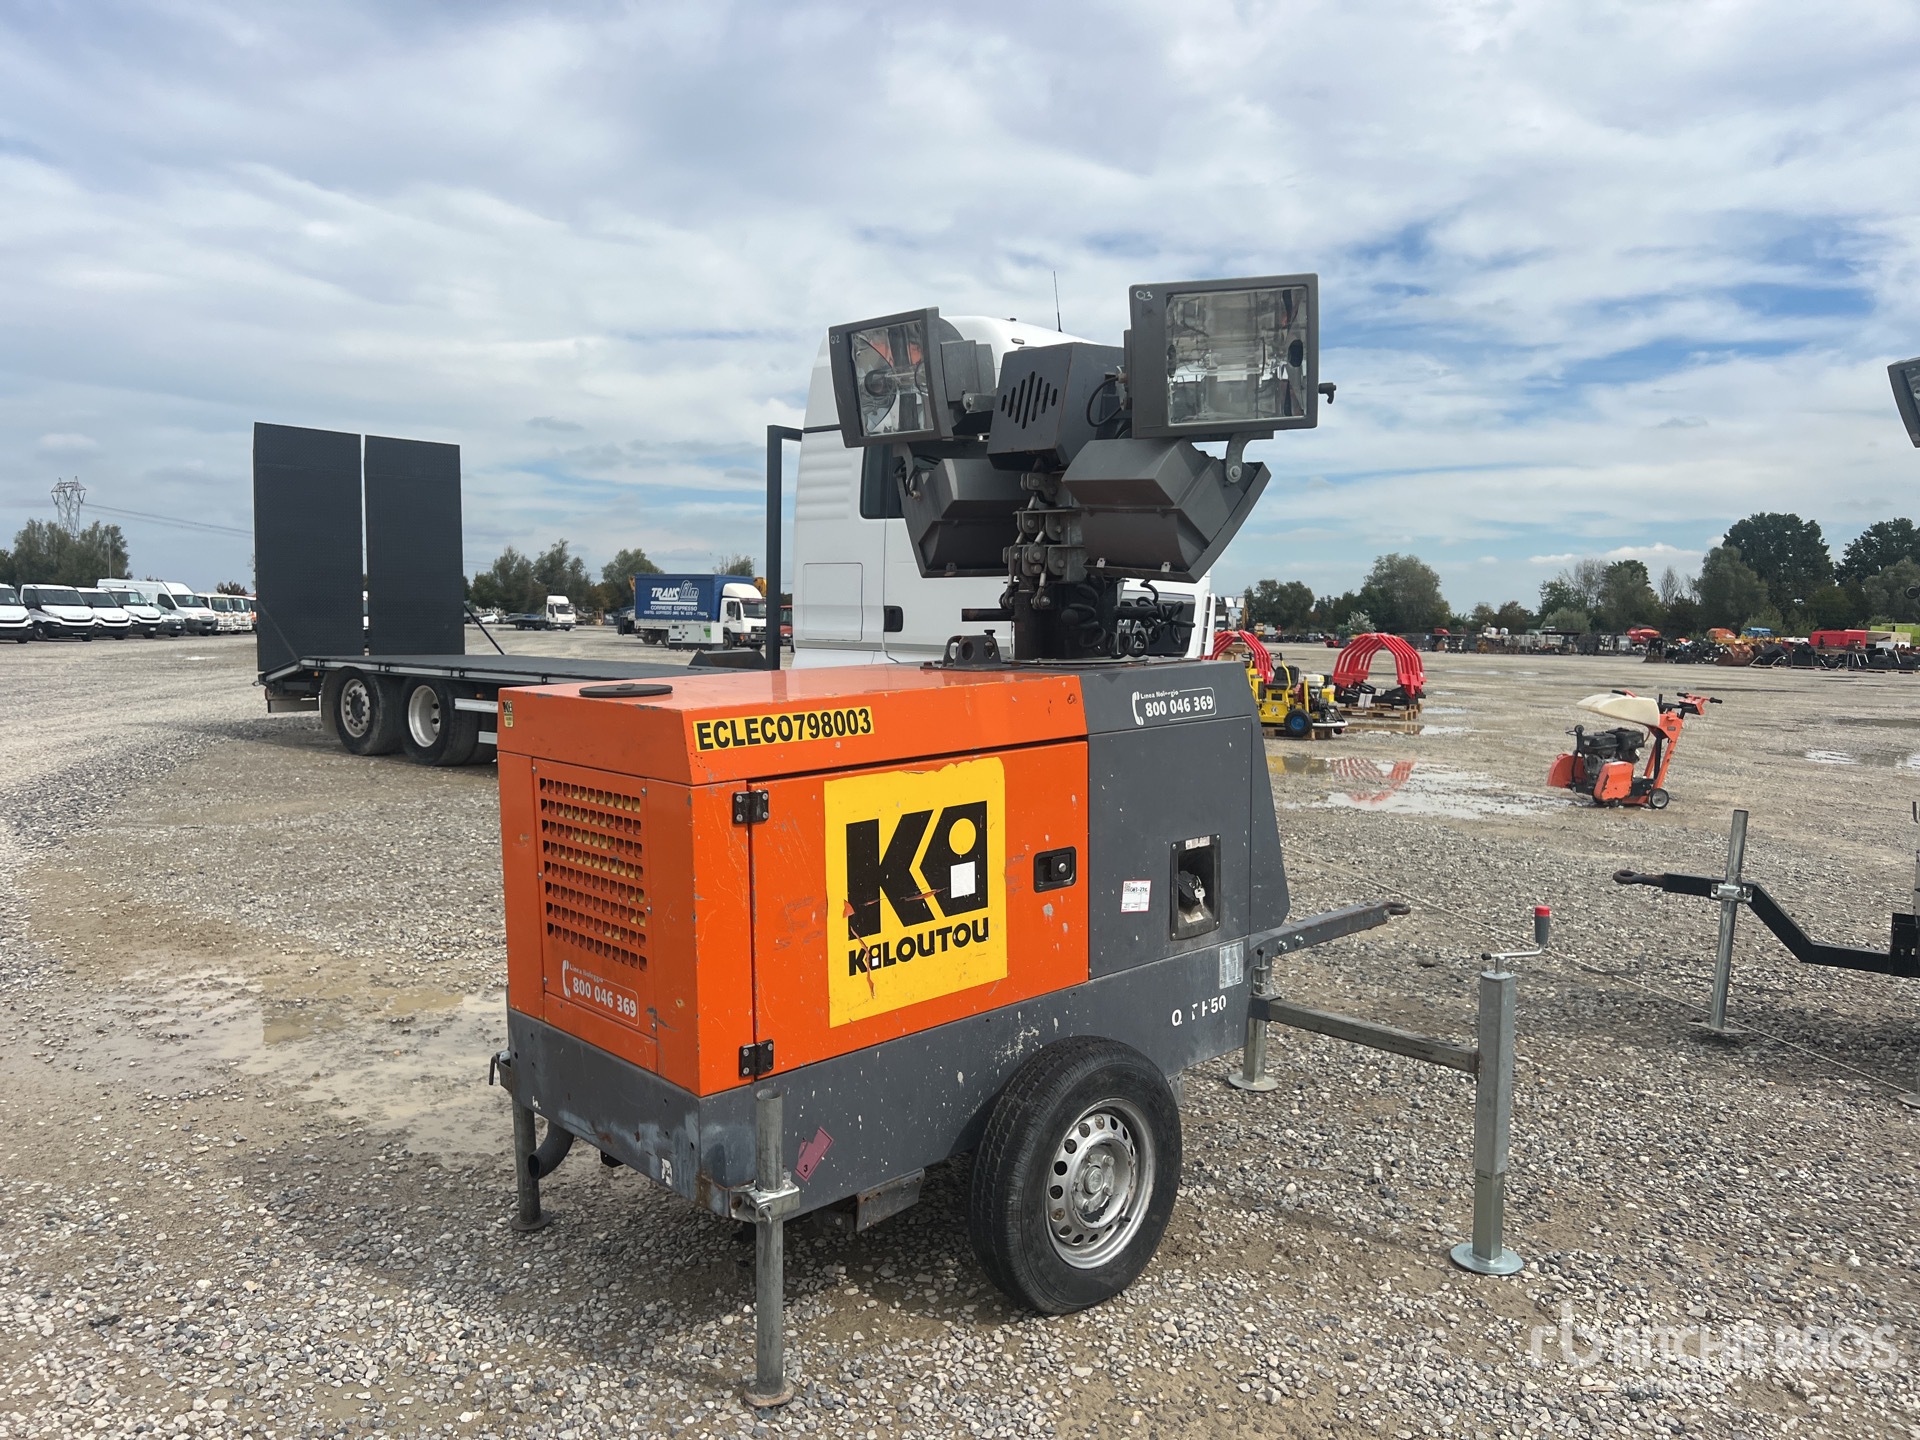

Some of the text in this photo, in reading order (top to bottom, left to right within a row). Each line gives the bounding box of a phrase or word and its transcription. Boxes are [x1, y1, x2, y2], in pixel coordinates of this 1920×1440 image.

[1145, 695, 1214, 717] 800 046 369
[572, 976, 637, 1018] 800 046 369
[803, 1164, 808, 1172] 3
